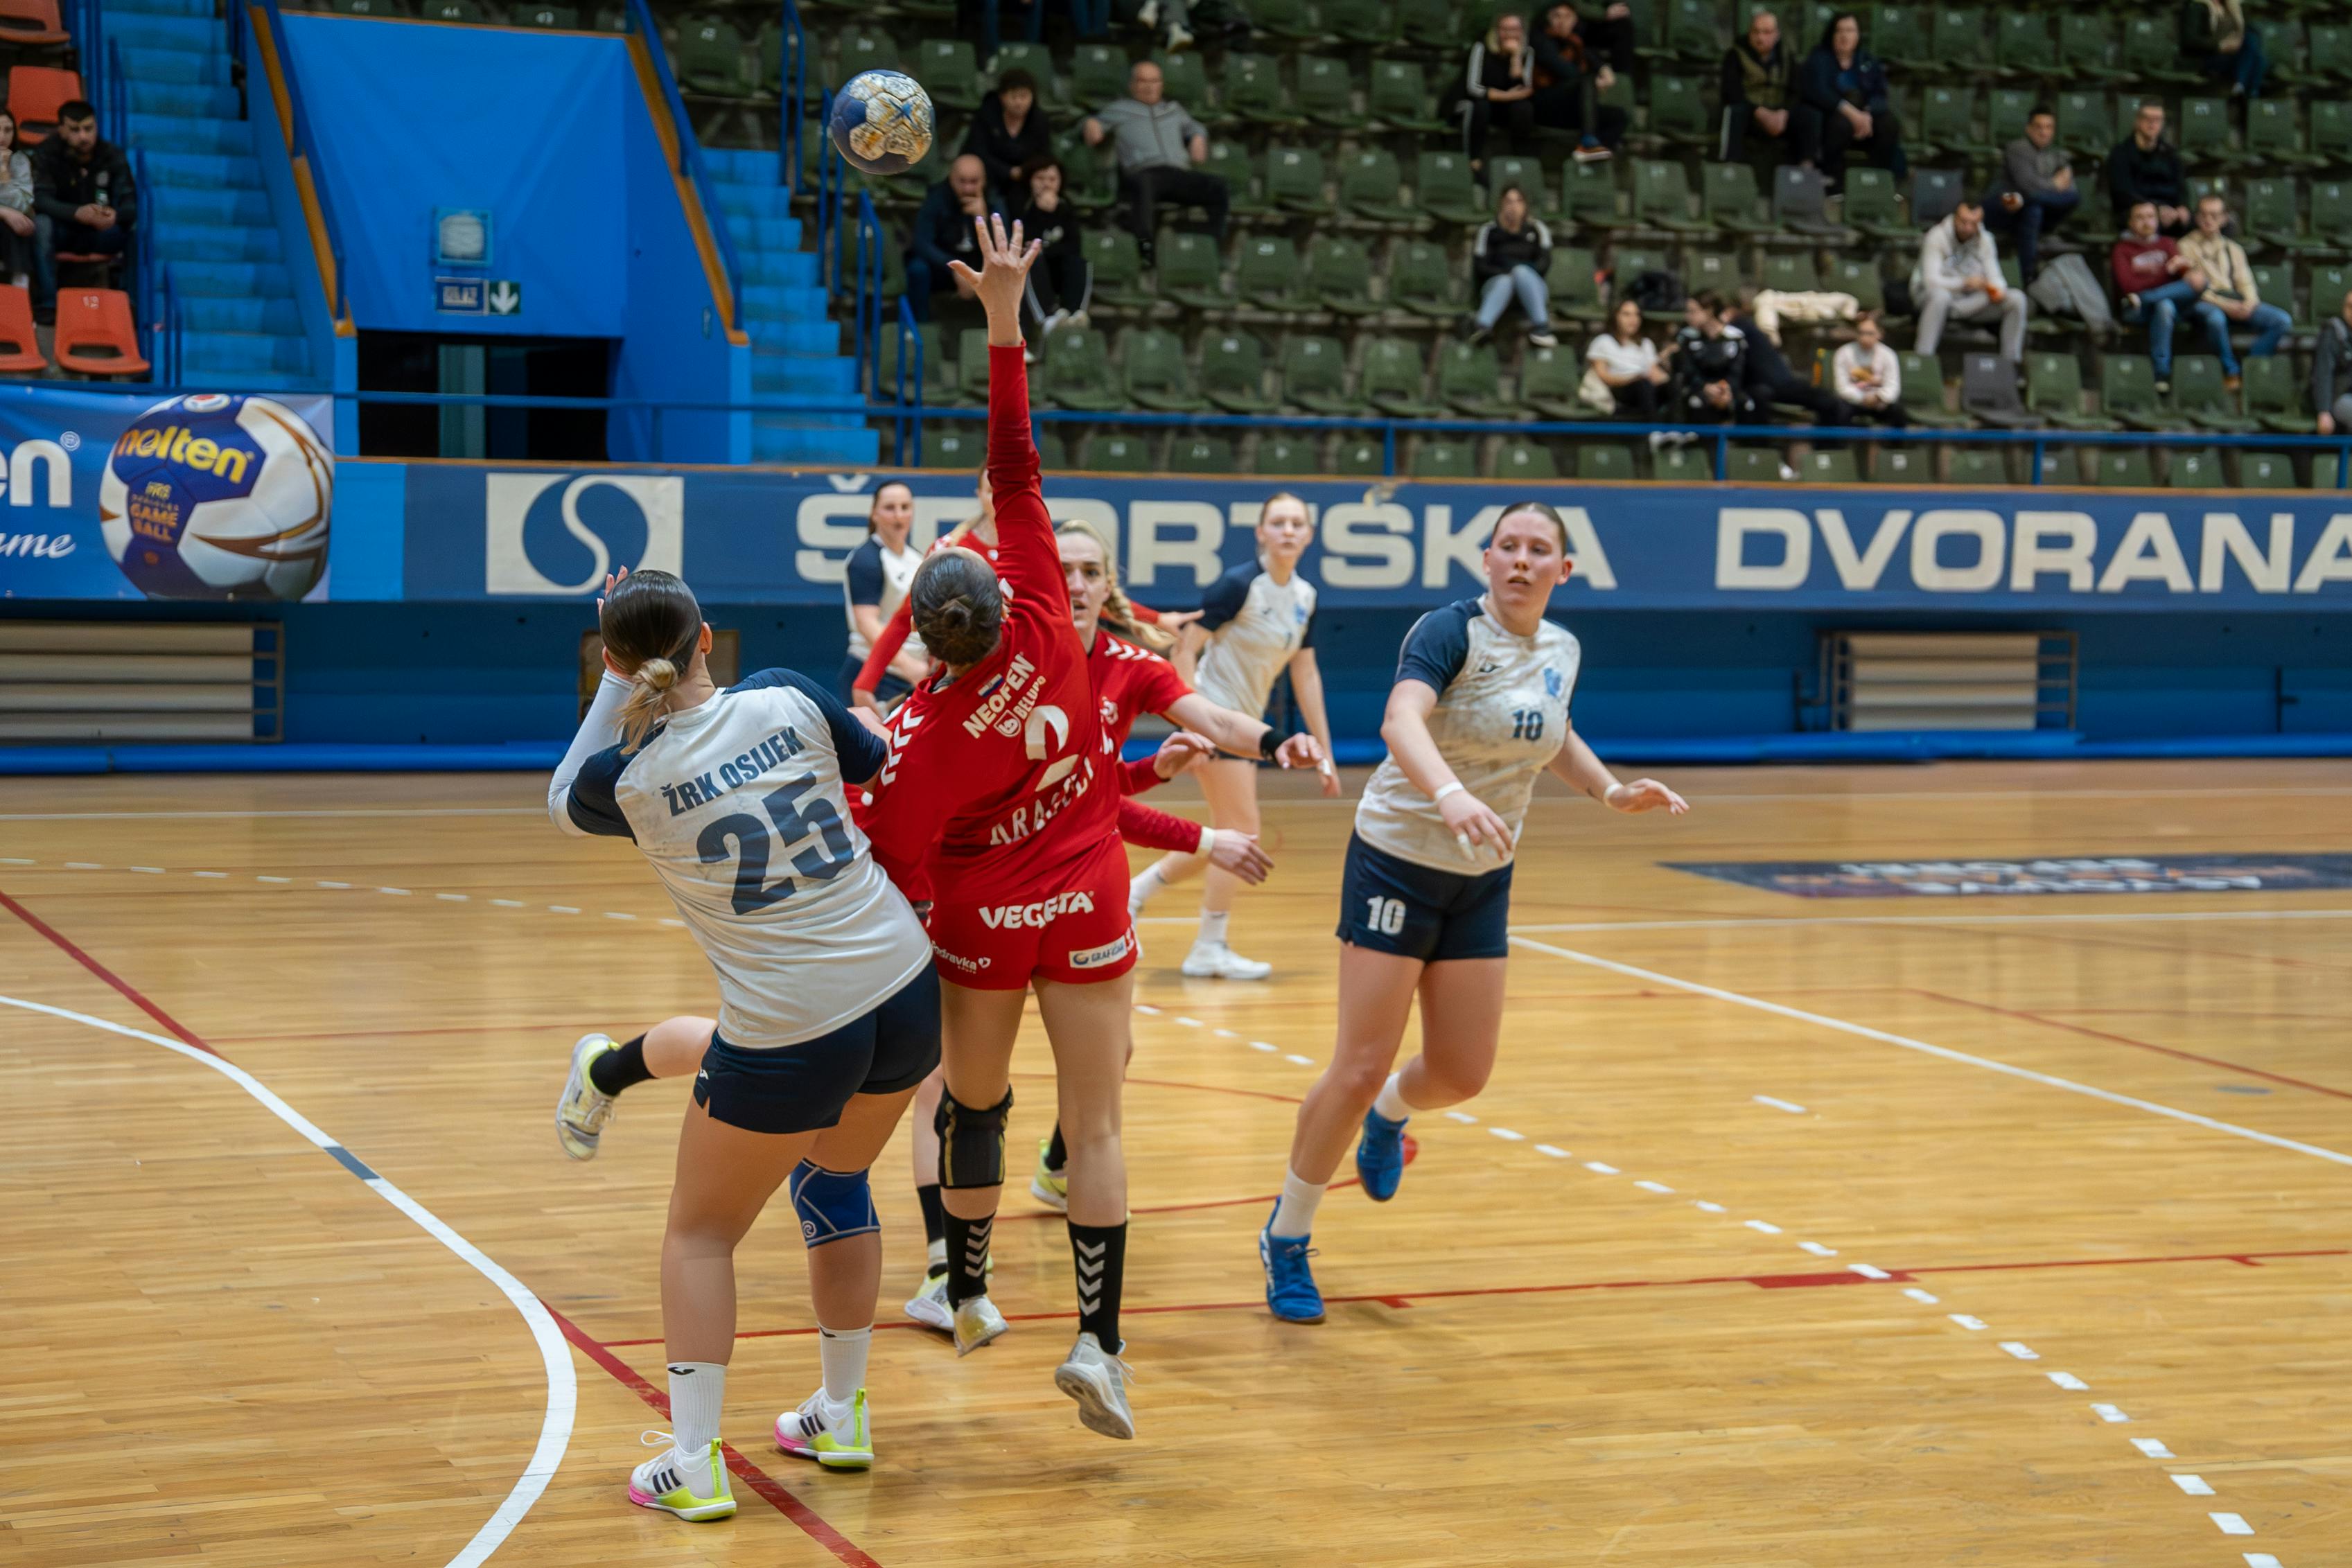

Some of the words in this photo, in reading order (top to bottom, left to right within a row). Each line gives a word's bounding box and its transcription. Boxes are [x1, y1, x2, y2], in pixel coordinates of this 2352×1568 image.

[1714, 507, 2352, 594] DVORANA
[962, 653, 1036, 739] NEOFEN
[1512, 709, 1544, 741] 10
[659, 777, 722, 817] ŽRK
[719, 725, 805, 790] OSIJEK
[696, 770, 854, 915] 25
[978, 891, 1094, 930] VEGETA
[1367, 895, 1407, 936] 10
